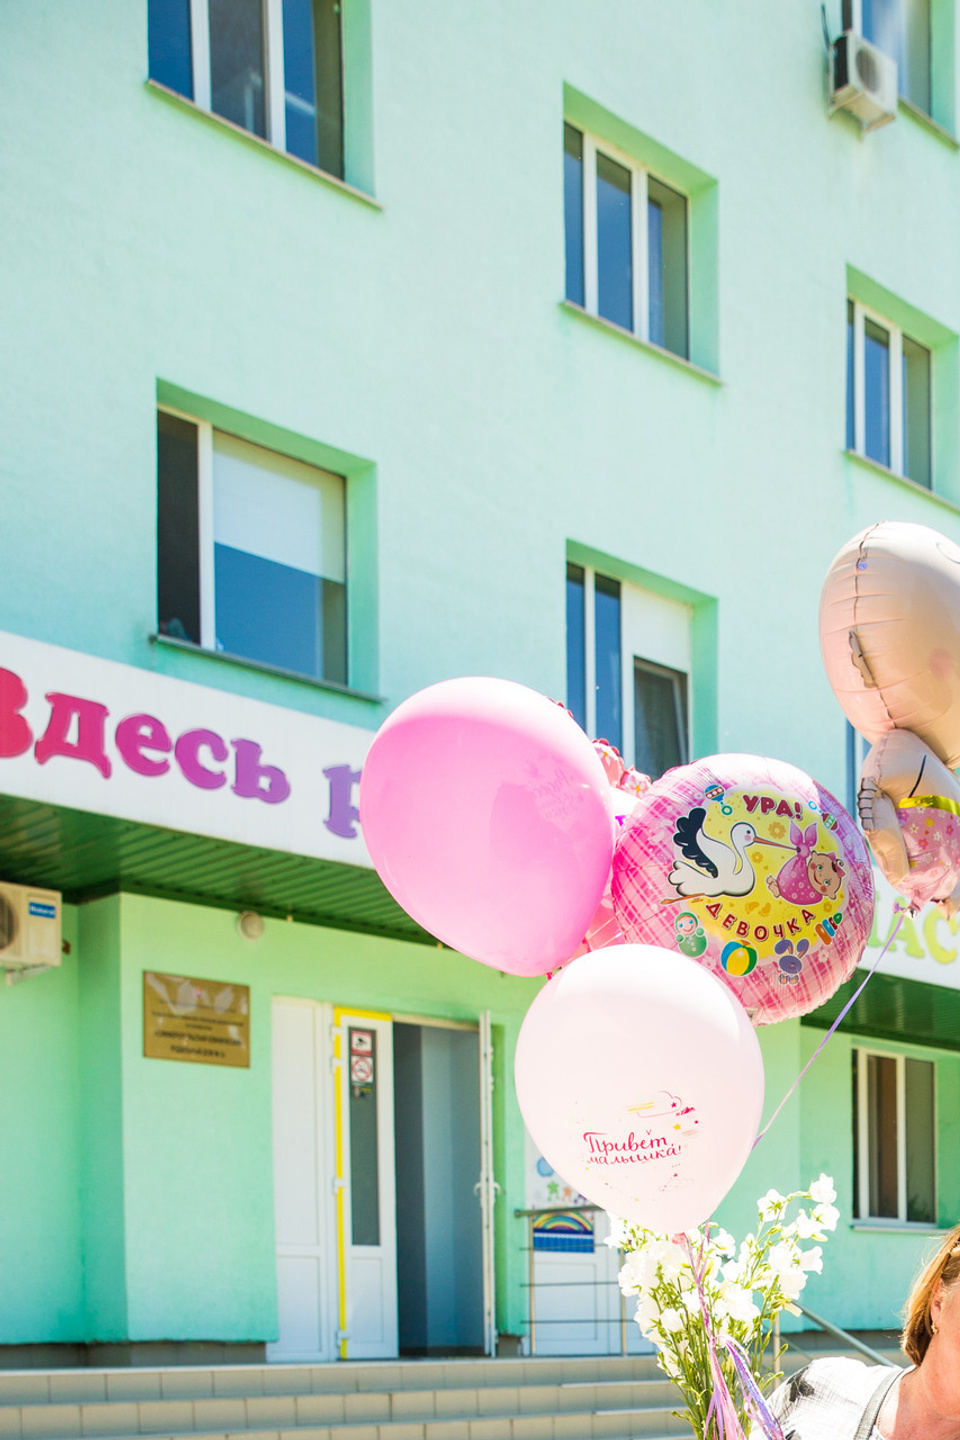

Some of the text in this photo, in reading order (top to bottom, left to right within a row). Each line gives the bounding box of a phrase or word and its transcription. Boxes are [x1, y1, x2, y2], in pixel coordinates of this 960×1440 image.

[742, 794, 802, 820] УРА!
[705, 902, 815, 941] ДЕВОЧКА
[587, 1143, 682, 1165] малышка!
